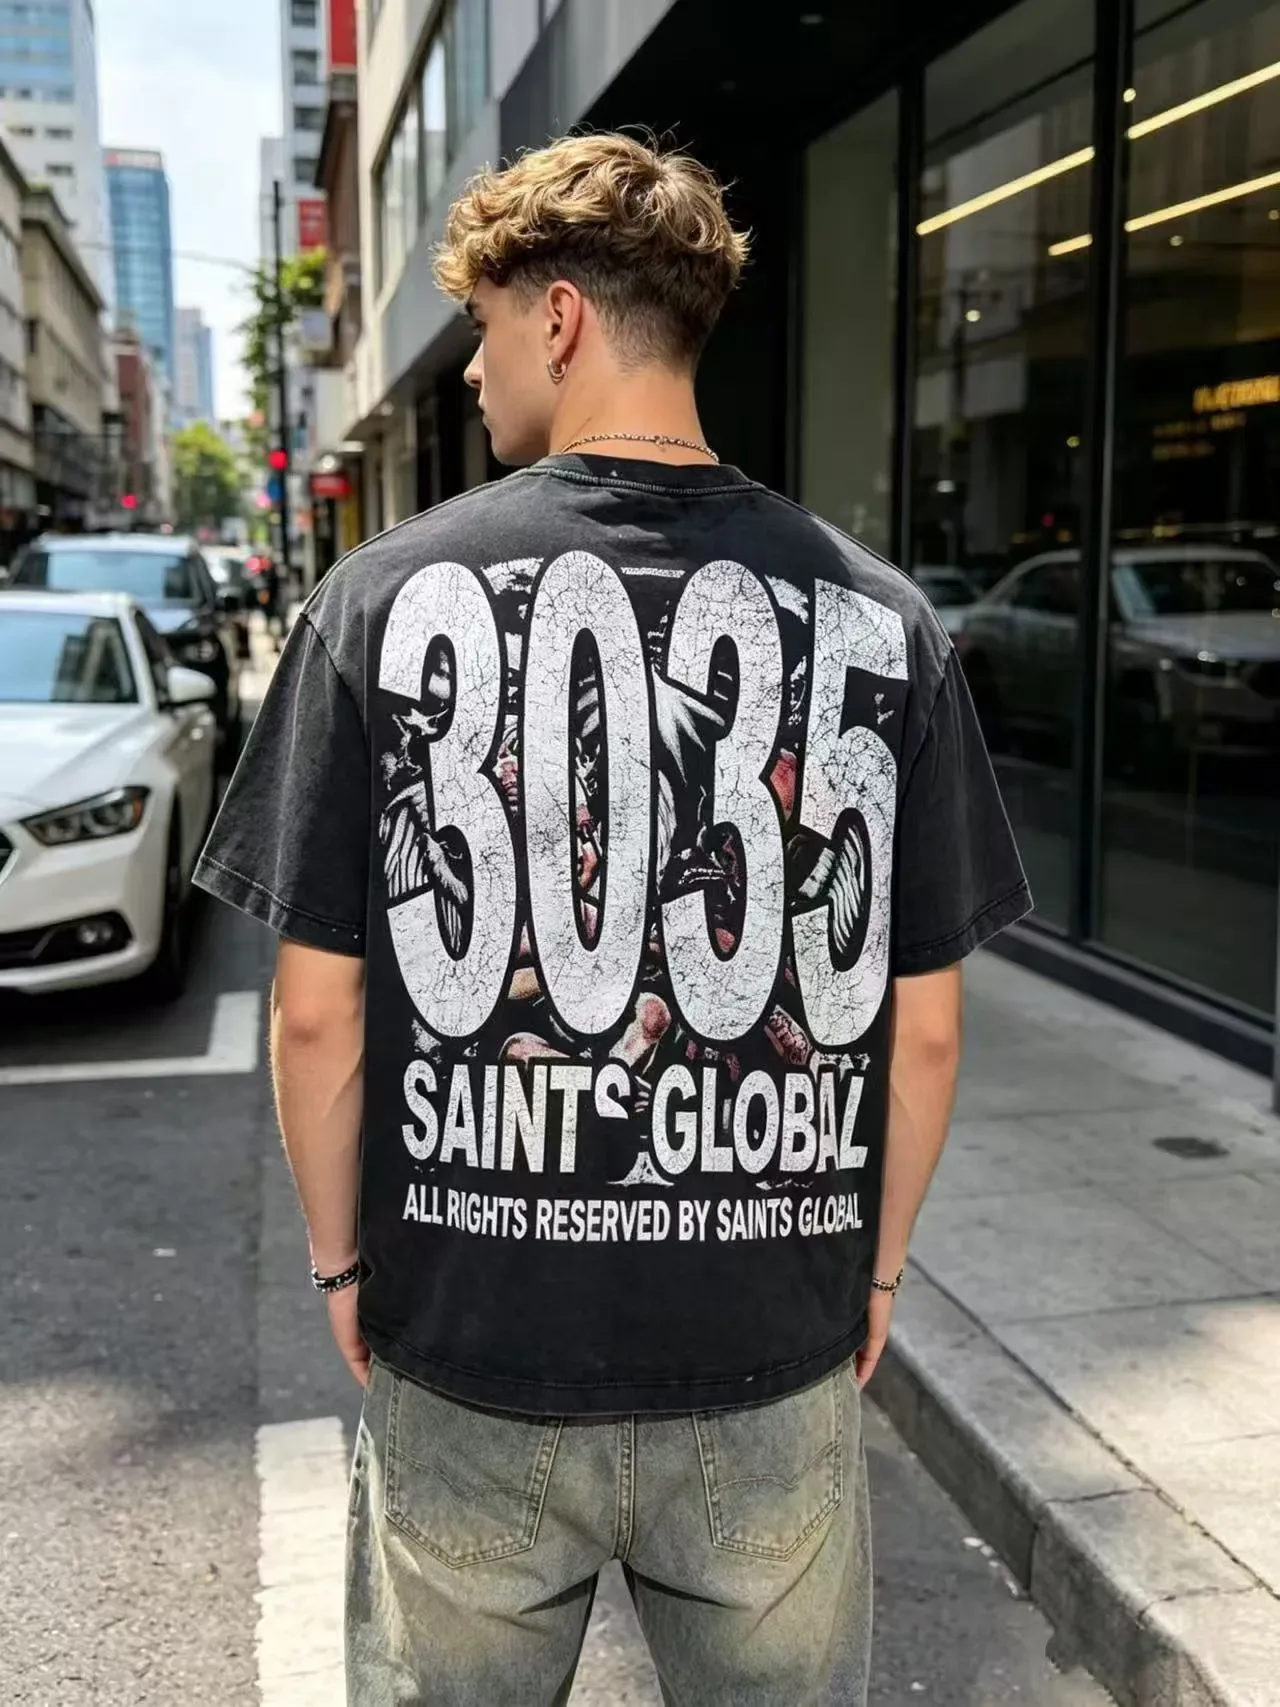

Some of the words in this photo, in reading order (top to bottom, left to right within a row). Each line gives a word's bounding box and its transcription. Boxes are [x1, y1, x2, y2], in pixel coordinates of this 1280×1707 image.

[378, 550, 909, 1046] 3035
[651, 1064, 869, 1175] GLOBAL
[402, 1183, 444, 1225] ALL
[446, 1188, 528, 1240] RIGHTS
[535, 1198, 671, 1242] RESERVED
[678, 1200, 711, 1242] BY
[715, 1198, 793, 1242] SAINTS
[797, 1192, 864, 1238] GLOBAL
